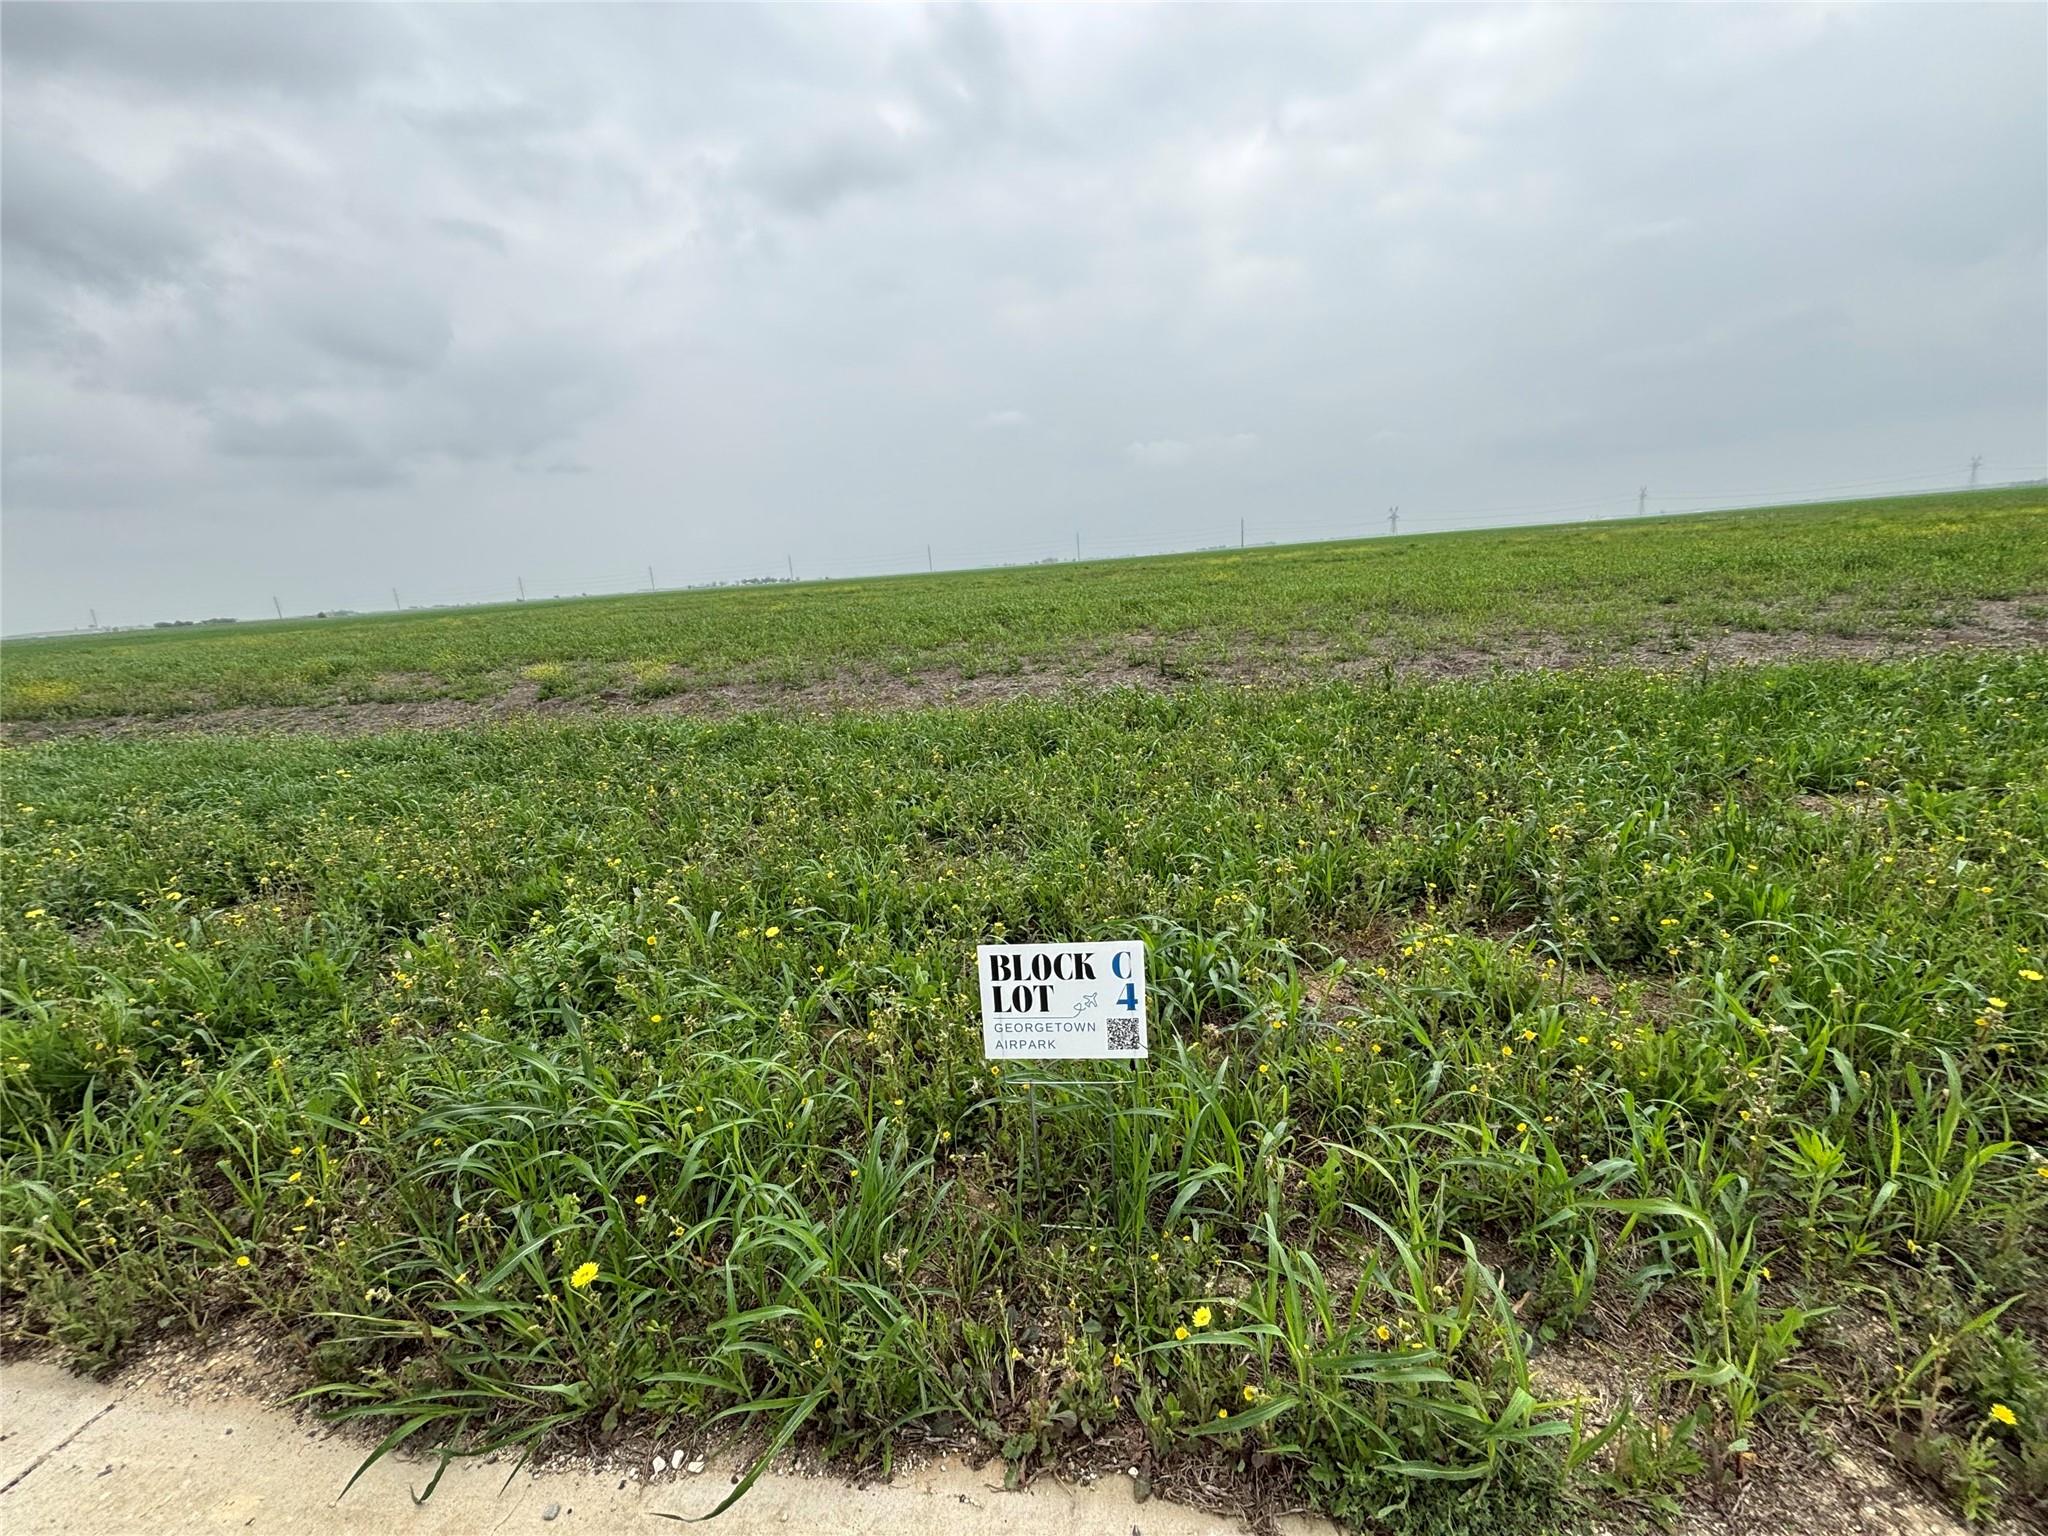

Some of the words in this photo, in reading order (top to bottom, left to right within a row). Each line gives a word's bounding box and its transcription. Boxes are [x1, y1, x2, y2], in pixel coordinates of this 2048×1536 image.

[990, 952, 1096, 981] BLOCK
[1112, 951, 1132, 979] C
[992, 985, 1055, 1013] LOT
[1116, 983, 1138, 1011] 4
[994, 1022, 1096, 1033] GEORGETOWN
[995, 1039, 1056, 1050] AIRPARK
